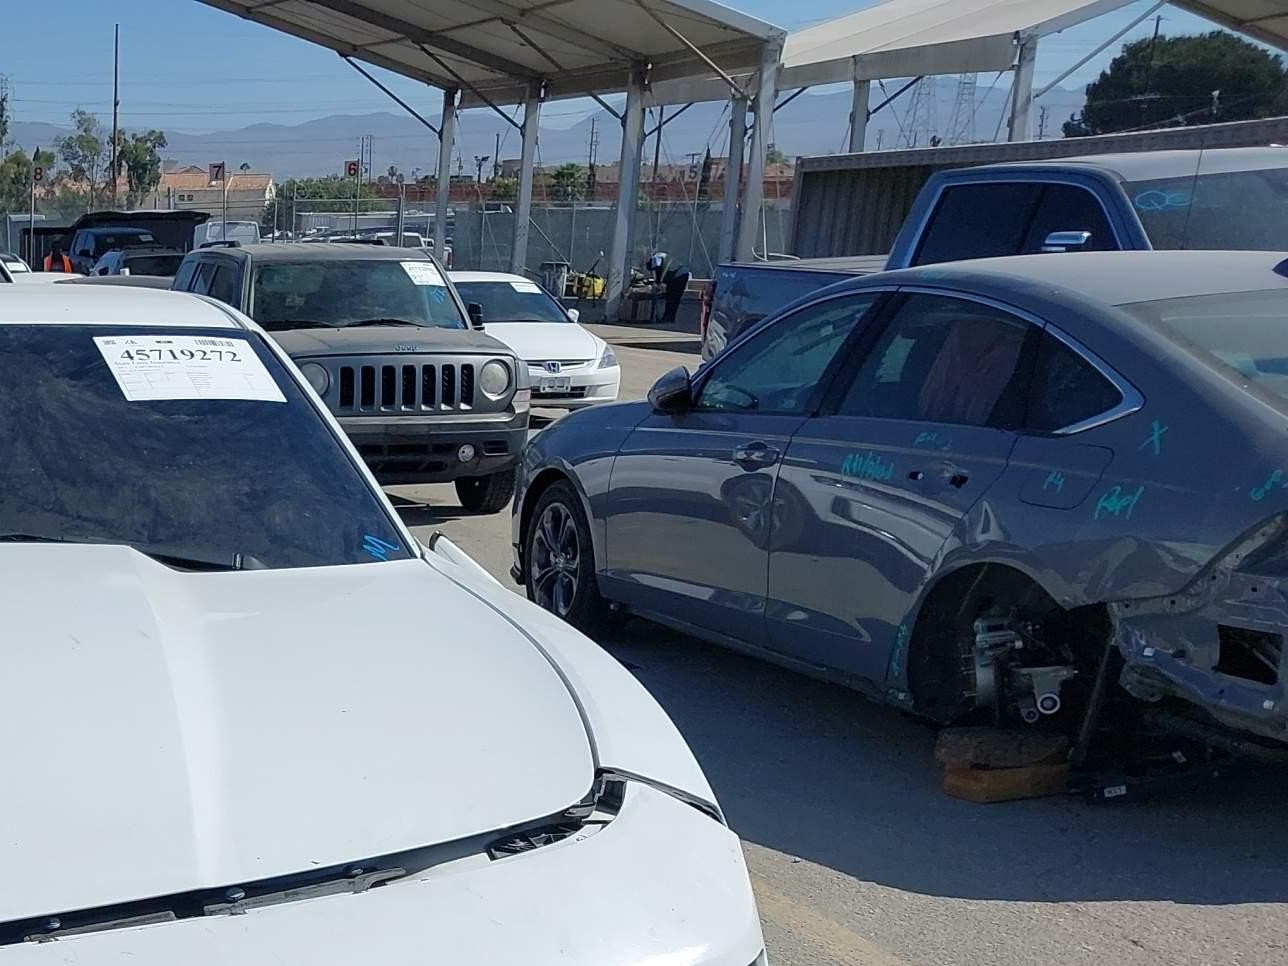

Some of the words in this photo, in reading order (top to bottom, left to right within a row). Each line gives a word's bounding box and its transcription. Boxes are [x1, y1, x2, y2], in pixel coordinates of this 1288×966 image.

[33, 166, 43, 181] 8
[212, 165, 222, 181] 7
[347, 163, 357, 177] 6
[689, 165, 697, 179] 5
[120, 349, 242, 362] 45719272
